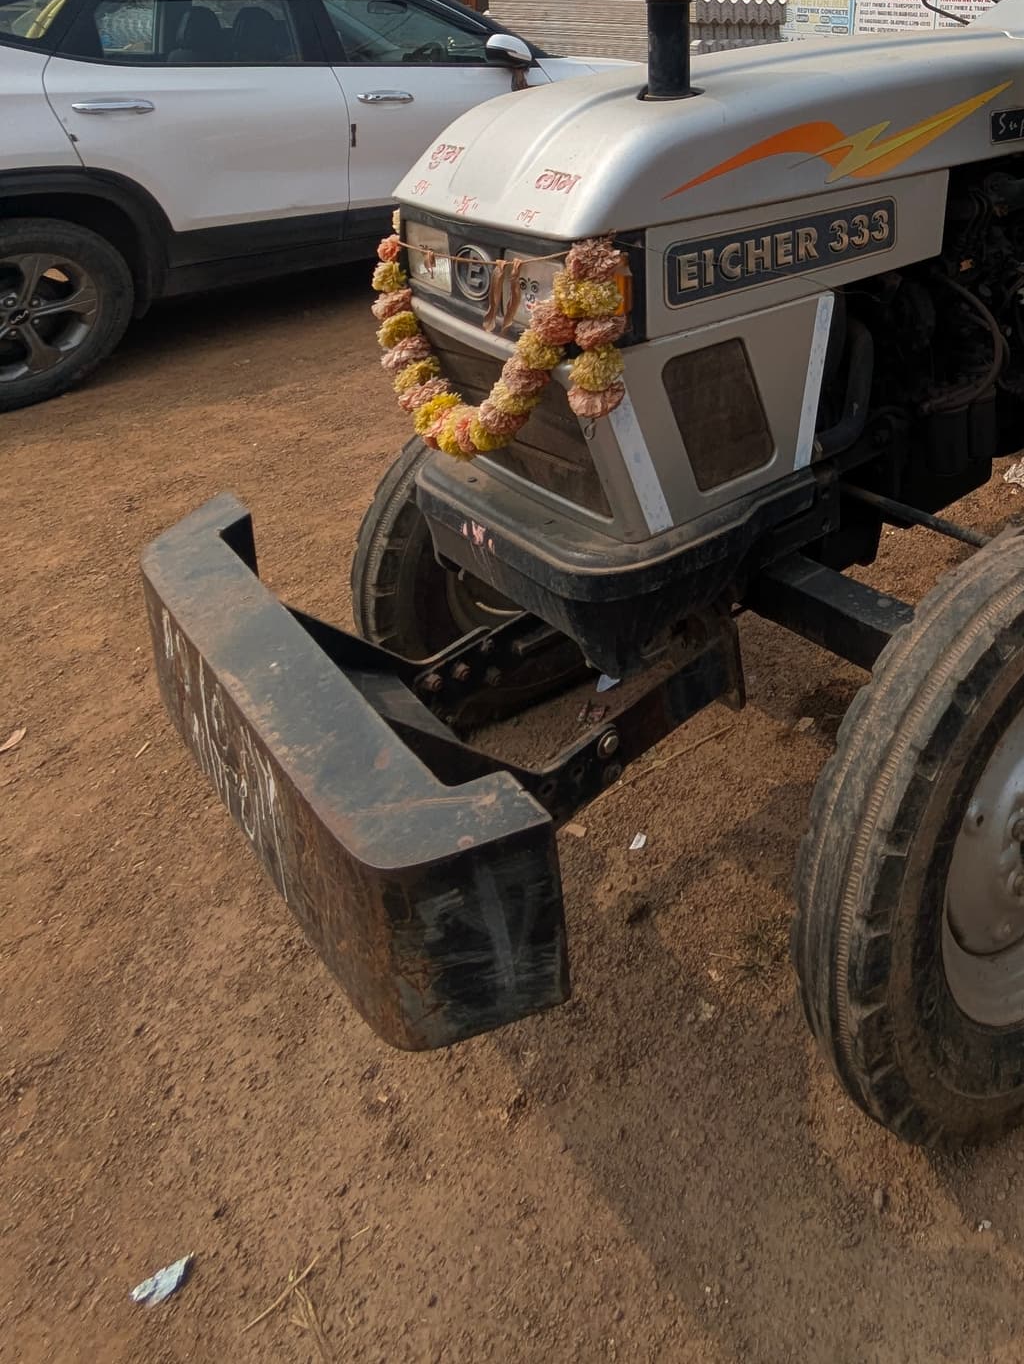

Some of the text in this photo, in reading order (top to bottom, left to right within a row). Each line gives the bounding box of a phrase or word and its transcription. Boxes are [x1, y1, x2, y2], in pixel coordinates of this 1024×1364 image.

[820, 8, 849, 16] CONCRETE
[676, 208, 890, 294] EICHER 333
